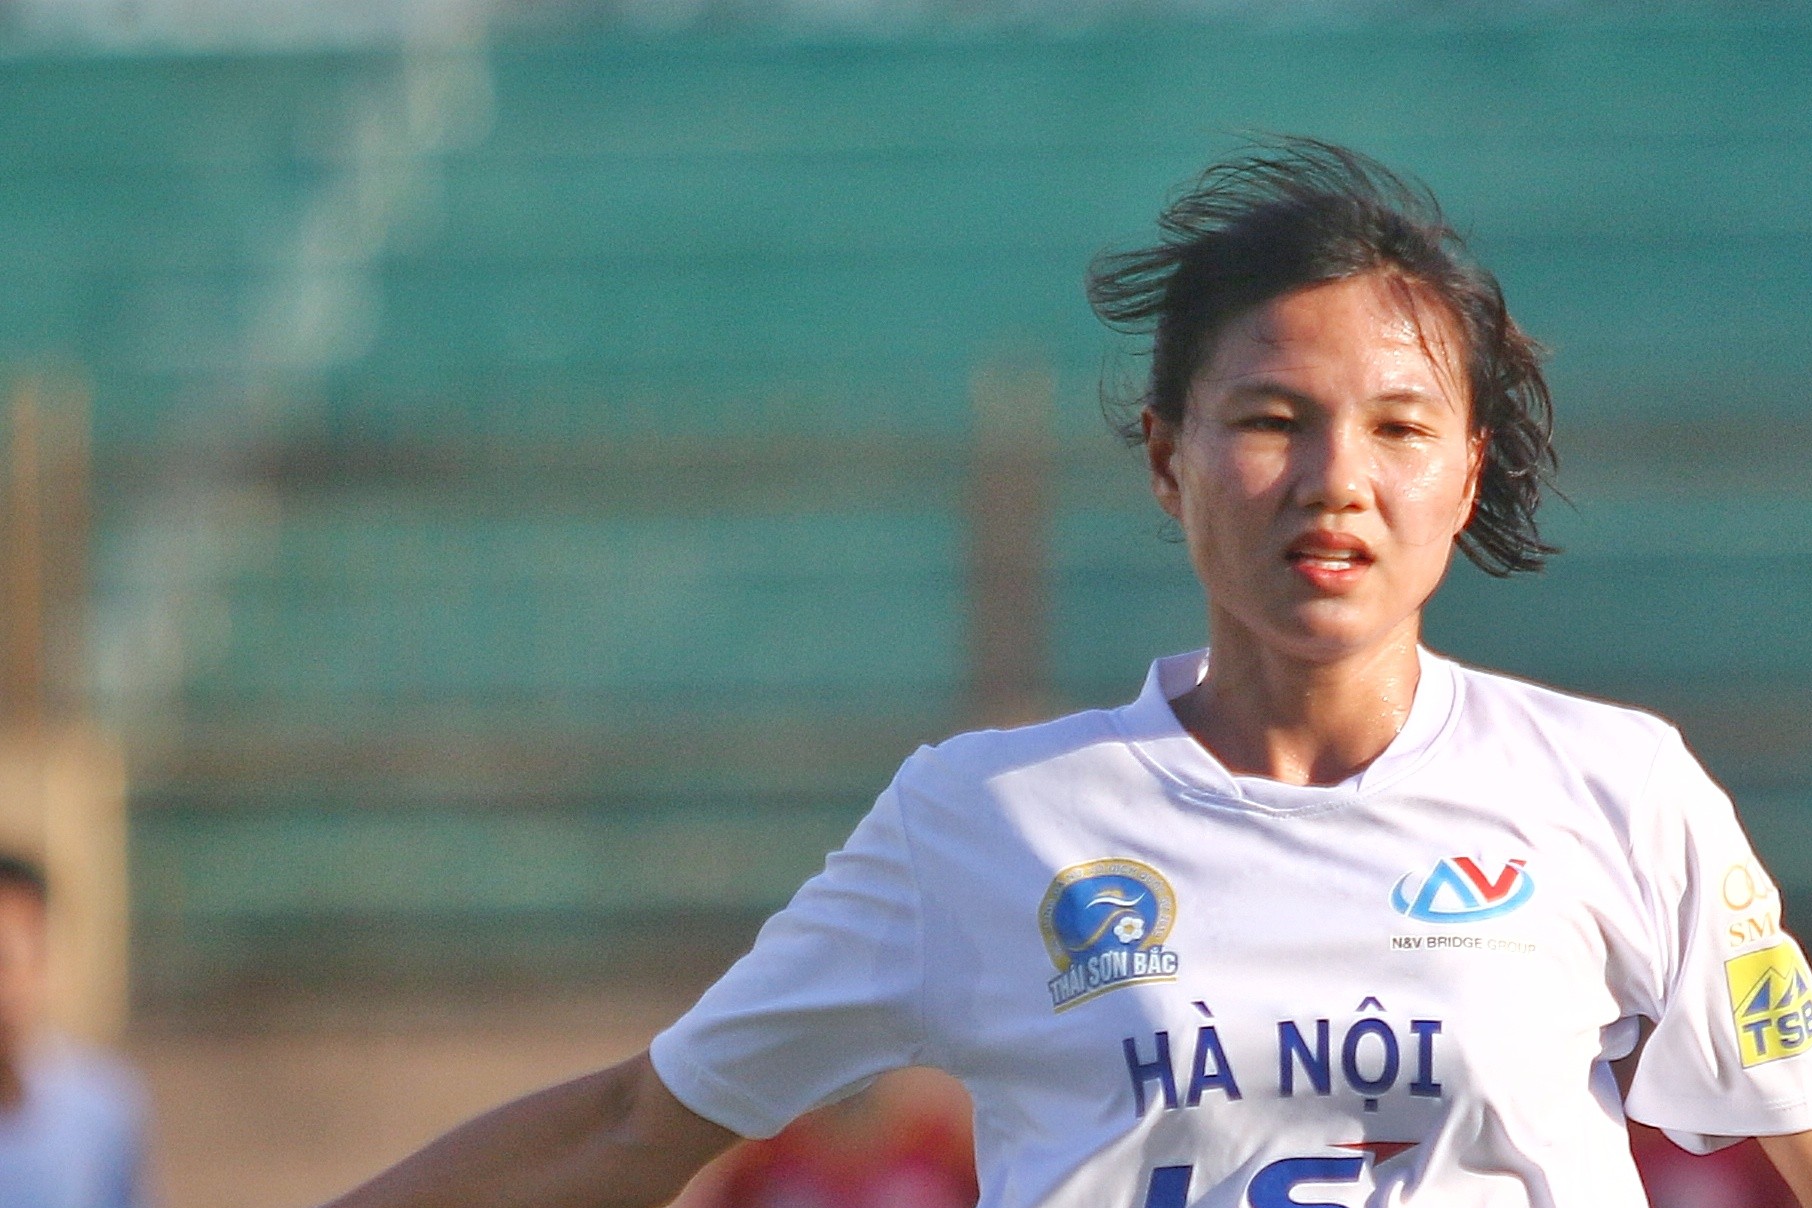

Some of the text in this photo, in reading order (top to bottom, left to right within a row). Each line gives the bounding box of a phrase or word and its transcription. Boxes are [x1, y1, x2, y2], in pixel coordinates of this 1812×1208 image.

[1391, 936, 1536, 953] N&V BRIDGE GROUP
[1050, 946, 1177, 1003] THÁI SƠN BẮC
[1123, 996, 1442, 1118] HÀ NỘI
